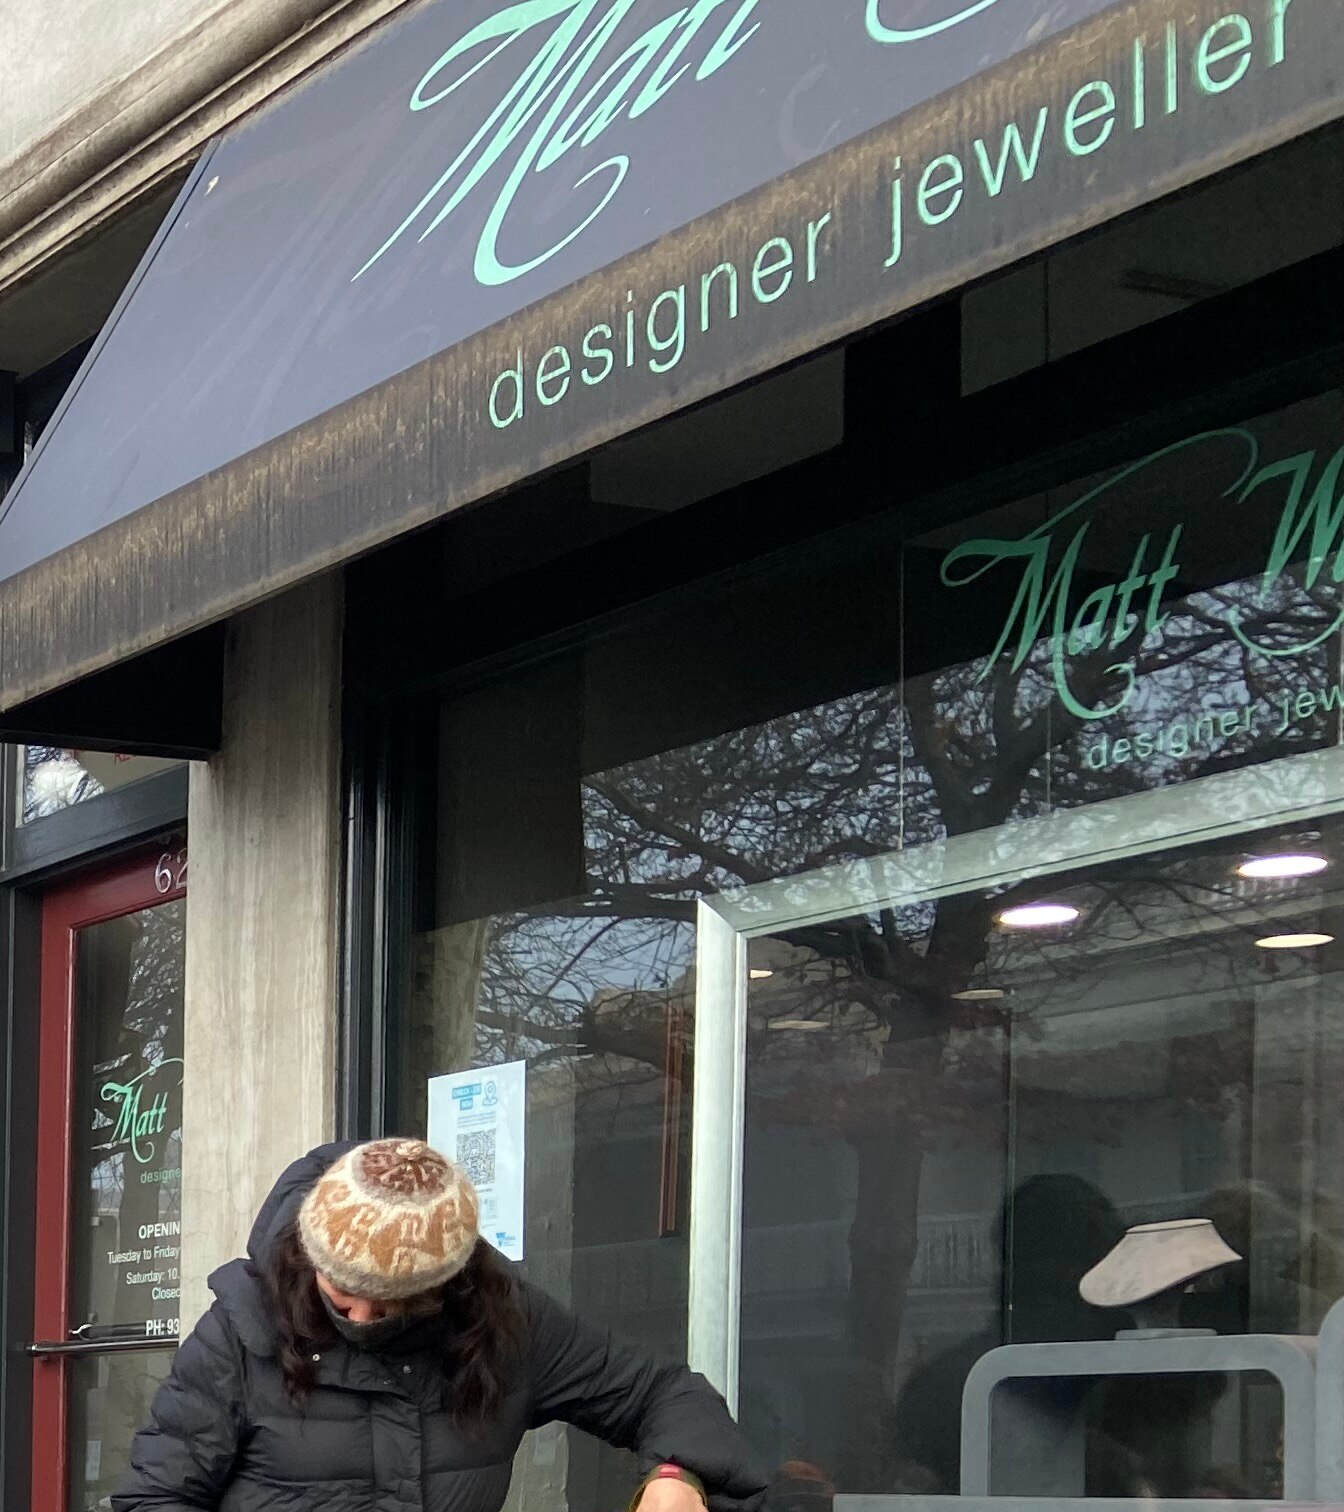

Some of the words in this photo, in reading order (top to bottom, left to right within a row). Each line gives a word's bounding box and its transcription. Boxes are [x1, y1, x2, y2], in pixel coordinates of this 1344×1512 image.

[487, 211, 832, 429] designer
[882, 0, 1292, 270] jeweller
[939, 427, 1259, 720] Matt
[1230, 444, 1344, 656] W
[1085, 702, 1260, 771] designer
[107, 1250, 141, 1265] Tuesday
[143, 1248, 151, 1260] to
[154, 1246, 180, 1261] Friday
[126, 1269, 165, 1285] Saturday:
[145, 1319, 164, 1336] PH:
